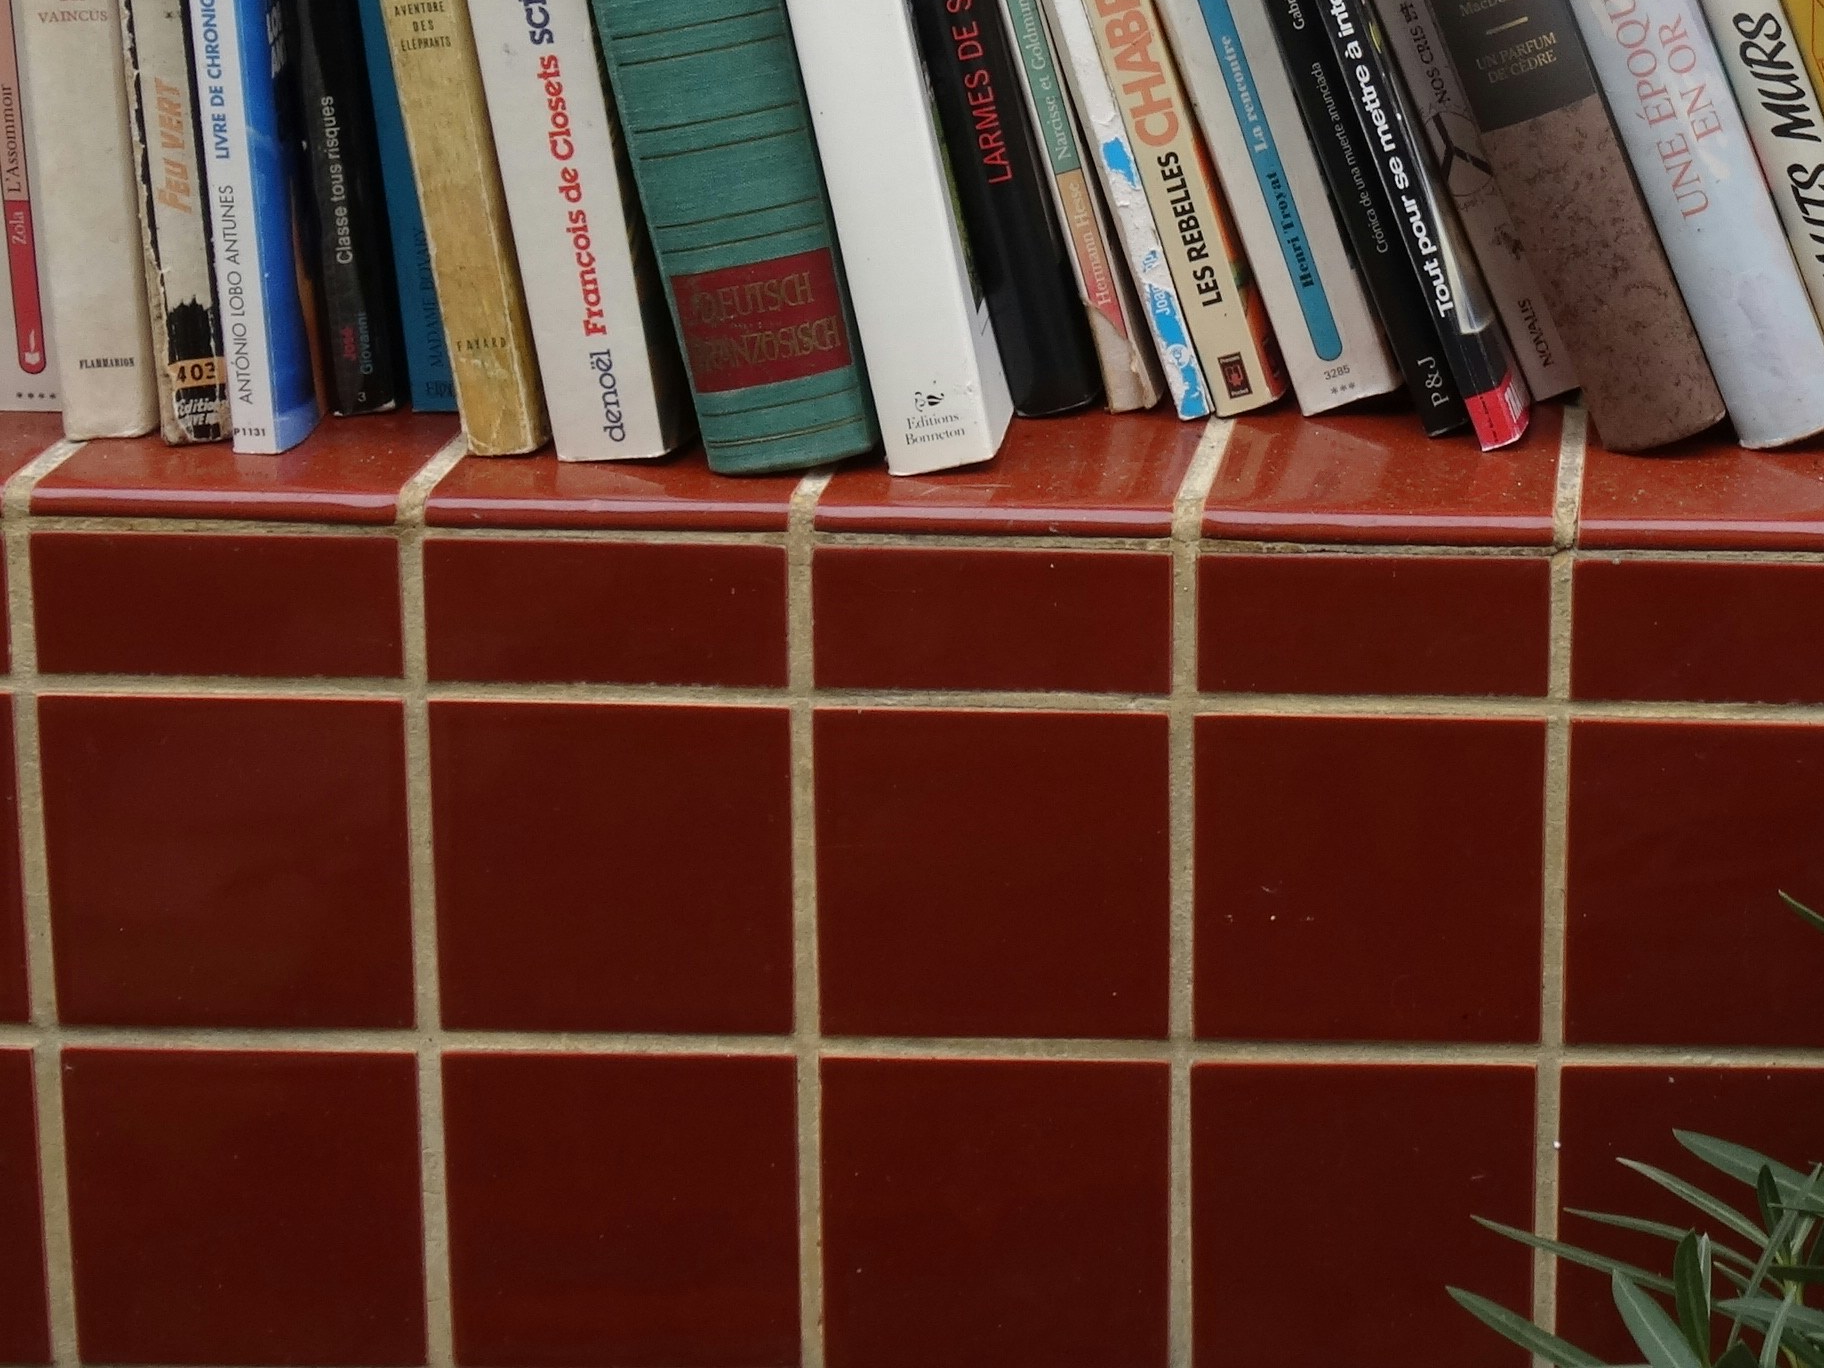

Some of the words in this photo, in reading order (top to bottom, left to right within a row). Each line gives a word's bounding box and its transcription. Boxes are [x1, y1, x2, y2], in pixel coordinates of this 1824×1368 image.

[36, 10, 108, 23] VAINCUS
[394, 1, 445, 16] AVENTURE
[412, 20, 434, 33] DES
[952, 21, 983, 61] DE
[1345, 40, 1363, 60] à
[1410, 21, 1434, 65] CRIS
[1476, 54, 1497, 71] UN
[1499, 32, 1557, 64] PARFUM
[1658, 13, 1697, 75] OR
[210, 84, 224, 108] DE
[1041, 74, 1051, 90] et
[1221, 35, 1259, 123] rencontre
[1311, 62, 1341, 123] anunciada
[1426, 66, 1450, 105] NOS
[1488, 67, 1506, 84] DE
[1732, 12, 1822, 144] MURS
[154, 77, 185, 148] VERT
[321, 95, 342, 161] risques
[537, 54, 575, 162] Closets
[965, 69, 1013, 184] LARMES
[1047, 95, 1071, 161] Narcisse
[1356, 65, 1396, 152] mettre
[1679, 83, 1723, 141] EN
[2, 85, 22, 192] L'Assommoir
[215, 113, 231, 159] LIVRE
[1250, 124, 1269, 153] La
[1334, 123, 1359, 164] muerte
[330, 164, 345, 203] tous
[558, 167, 585, 204] de
[1351, 166, 1363, 187] una
[1390, 156, 1410, 189] se
[1656, 132, 1709, 220] UNE
[1069, 183, 1089, 228] Hesse
[1157, 151, 1208, 263] REBELLES
[1266, 172, 1294, 237] Troyat
[1359, 190, 1371, 208] de
[11, 211, 27, 245] Zola
[219, 184, 240, 264] ANTUNES
[335, 203, 353, 265] Classe
[1366, 209, 1389, 254] Crónica
[1402, 195, 1437, 256] pour
[565, 210, 608, 338] François
[1083, 231, 1111, 305] Hermann
[1288, 239, 1315, 289] Henri
[226, 270, 246, 319] LOBO
[698, 271, 815, 322] DEUTSCH
[1192, 266, 1223, 308] LES
[1423, 259, 1455, 318] Tout
[356, 312, 373, 376] Giovanni
[457, 336, 507, 352] FAYARD
[1518, 297, 1553, 368] NOVALIS
[79, 357, 135, 370] FLAMMARION
[176, 361, 216, 383] 403
[231, 322, 252, 404] ANTÓNIO
[1323, 364, 1351, 381] 3285
[357, 391, 367, 402] 3
[589, 349, 626, 443] denoël
[233, 427, 266, 438] P1131
[905, 426, 966, 446] Bonneton
